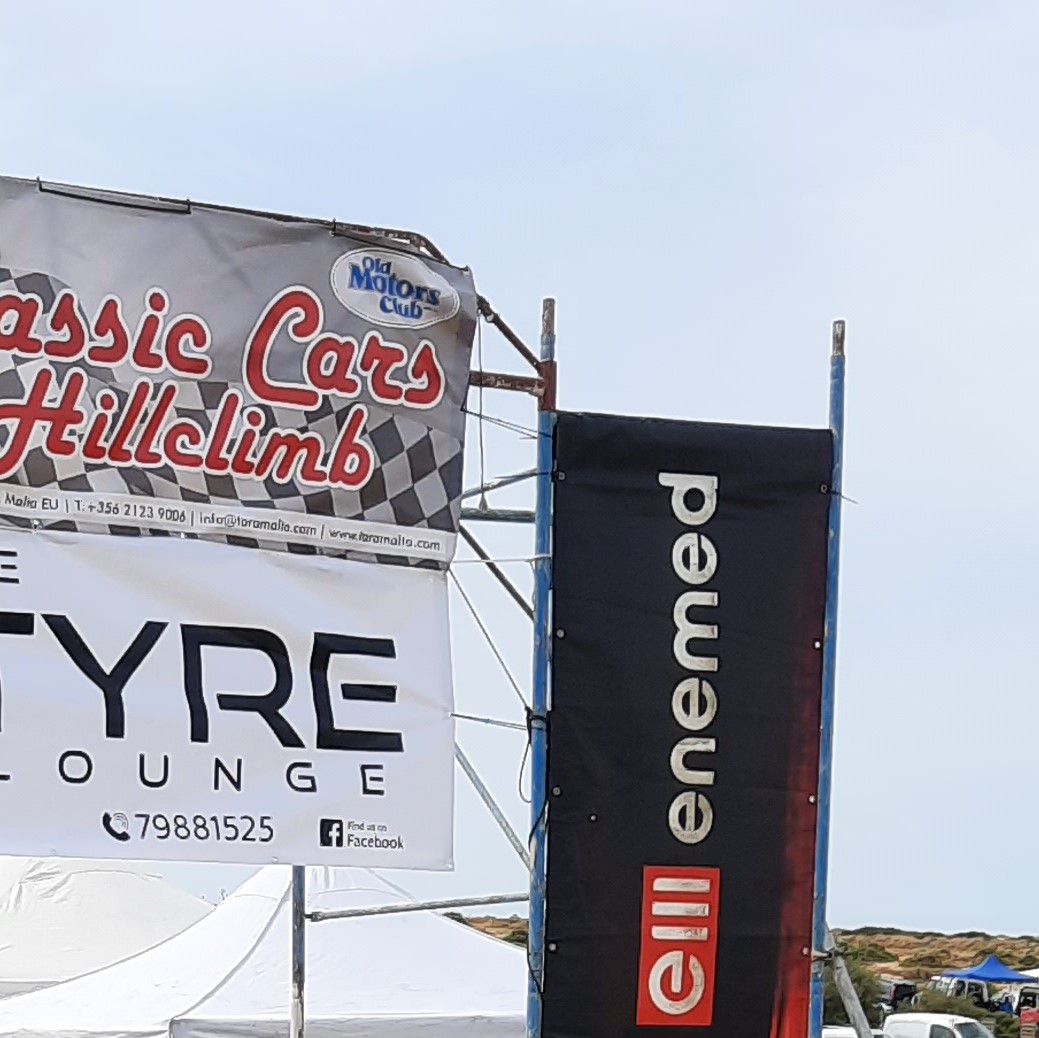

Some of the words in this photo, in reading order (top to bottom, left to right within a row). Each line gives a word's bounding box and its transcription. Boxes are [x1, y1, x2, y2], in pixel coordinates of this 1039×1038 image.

[361, 256, 392, 275] Old
[348, 261, 441, 305] Motors
[379, 295, 424, 319] Club
[245, 287, 445, 408] Cars
[41, 496, 59, 511] EU
[124, 504, 154, 518] 2123
[158, 507, 187, 522] 9006
[658, 472, 719, 845] enemed
[133, 811, 276, 844] 79881525
[347, 833, 404, 850] Facebook
